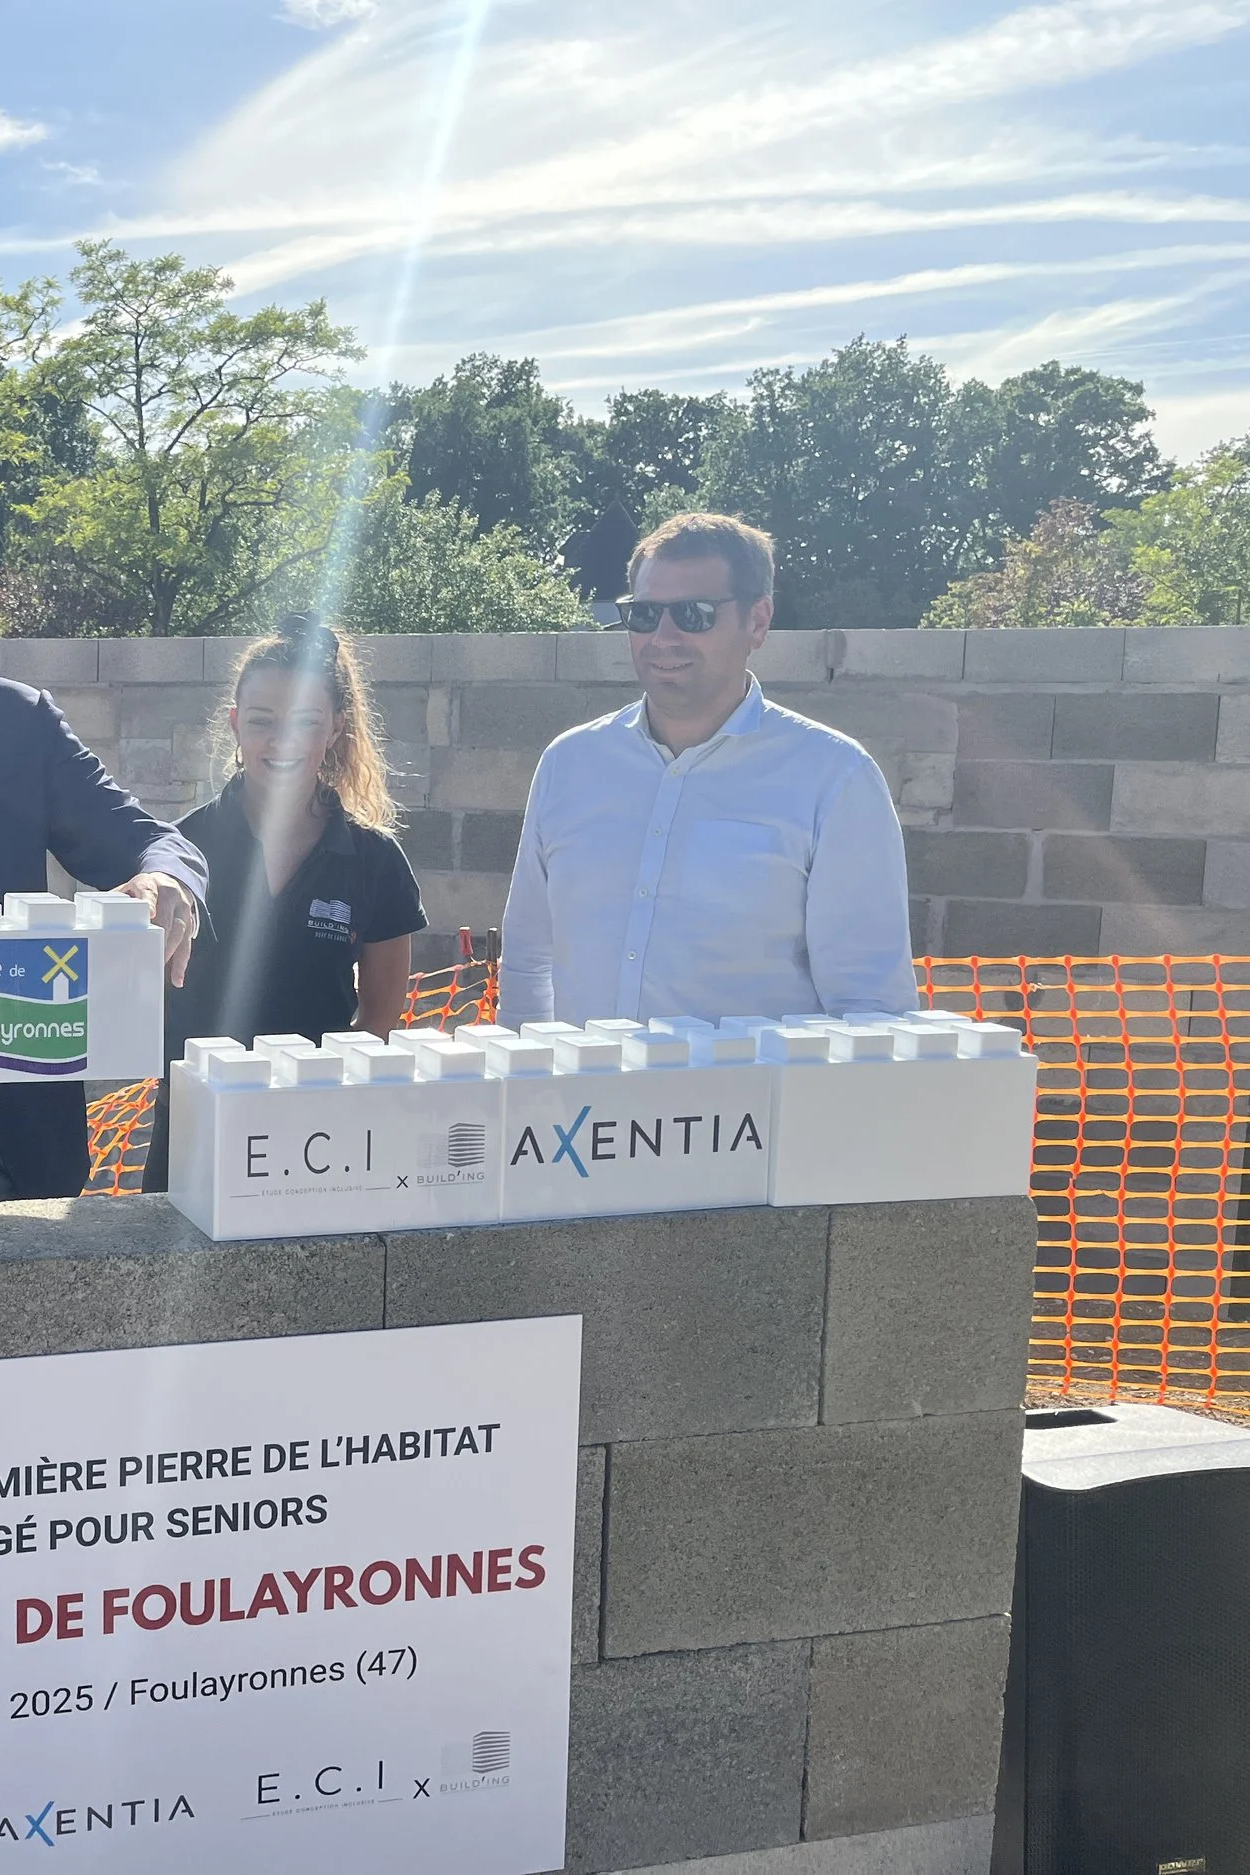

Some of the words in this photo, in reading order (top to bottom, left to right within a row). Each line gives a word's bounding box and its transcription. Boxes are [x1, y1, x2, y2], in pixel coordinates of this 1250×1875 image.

[9, 964, 26, 978] de
[510, 1105, 763, 1177] AXENTIA
[417, 1170, 485, 1184] BUILD'ING
[119, 1446, 252, 1487] PIERRE
[263, 1440, 310, 1474] DE
[50, 1512, 155, 1551] POUR
[166, 1494, 329, 1539] SENIORS
[16, 1592, 84, 1645] DE
[102, 1544, 546, 1635] FOULAYRONNES
[10, 1685, 93, 1721] 2025
[104, 1682, 118, 1711] /
[130, 1658, 345, 1706] Foulayronnes
[356, 1645, 418, 1685] (47)
[440, 1776, 510, 1792] BUILD'ING
